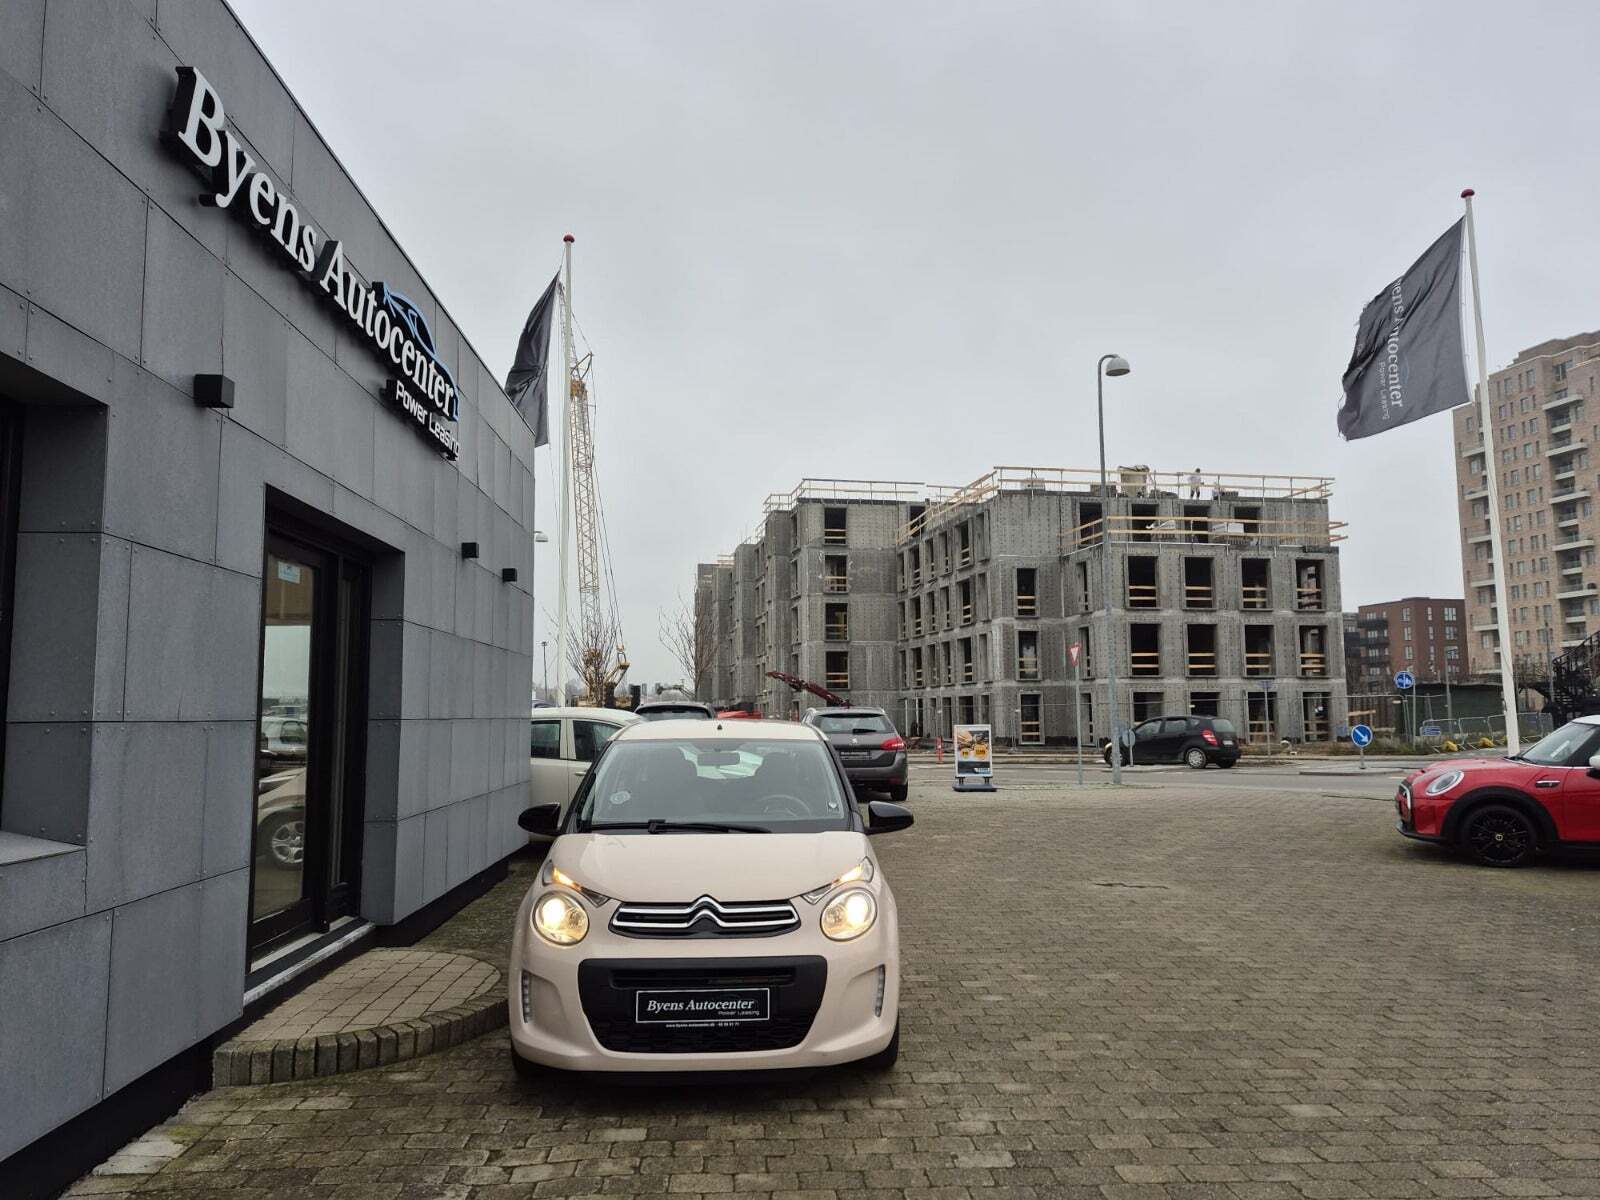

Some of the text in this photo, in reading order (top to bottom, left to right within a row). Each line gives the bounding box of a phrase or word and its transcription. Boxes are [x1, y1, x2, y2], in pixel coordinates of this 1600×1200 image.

[178, 67, 456, 417] Byens Autocenter
[395, 380, 461, 462] Power Leasing
[646, 999, 755, 1014] Byens Autocenter
